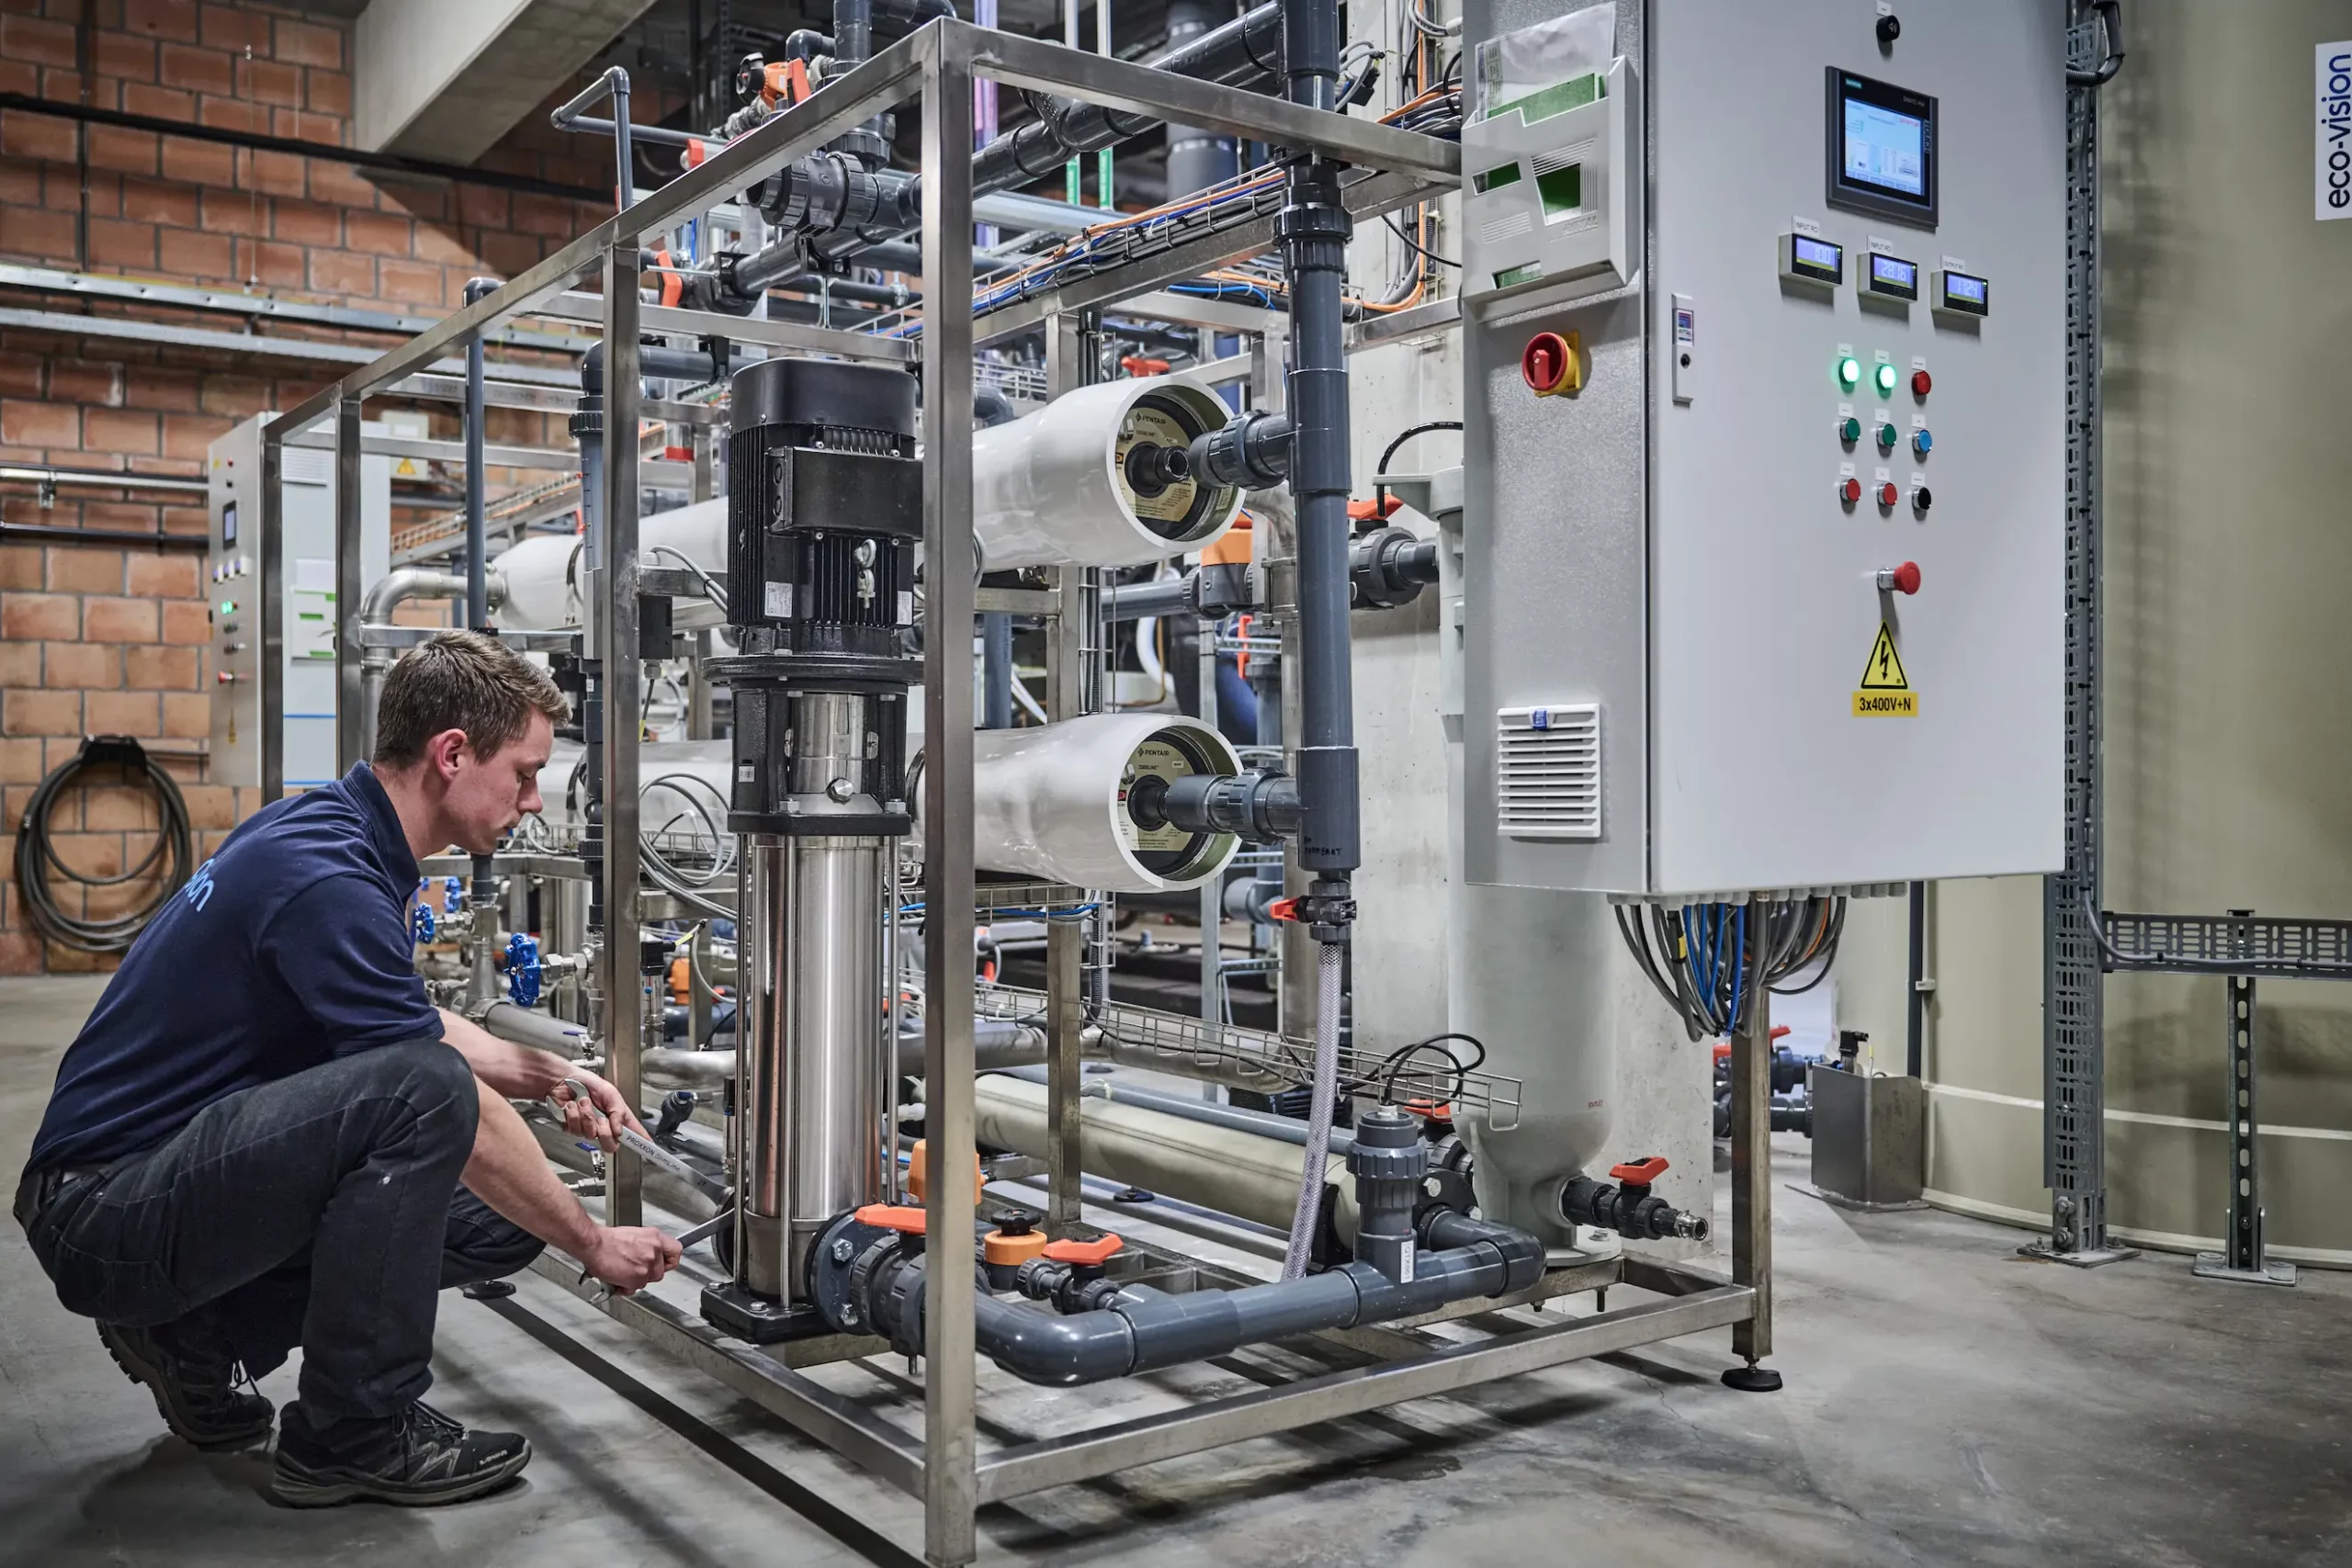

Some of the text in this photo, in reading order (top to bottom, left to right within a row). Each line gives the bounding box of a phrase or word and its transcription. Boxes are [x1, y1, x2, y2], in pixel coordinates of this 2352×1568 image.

[1923, 118, 1932, 154] TOUCH
[2321, 53, 2352, 209] eco-vision
[1795, 221, 1810, 231] INPUT
[1871, 242, 1883, 251] INPUT
[1142, 414, 1167, 424] PENTAIR
[1860, 696, 1912, 712] 3x400V+N
[1145, 749, 1170, 757] PENTAIR
[626, 1134, 655, 1156] PROXXON
